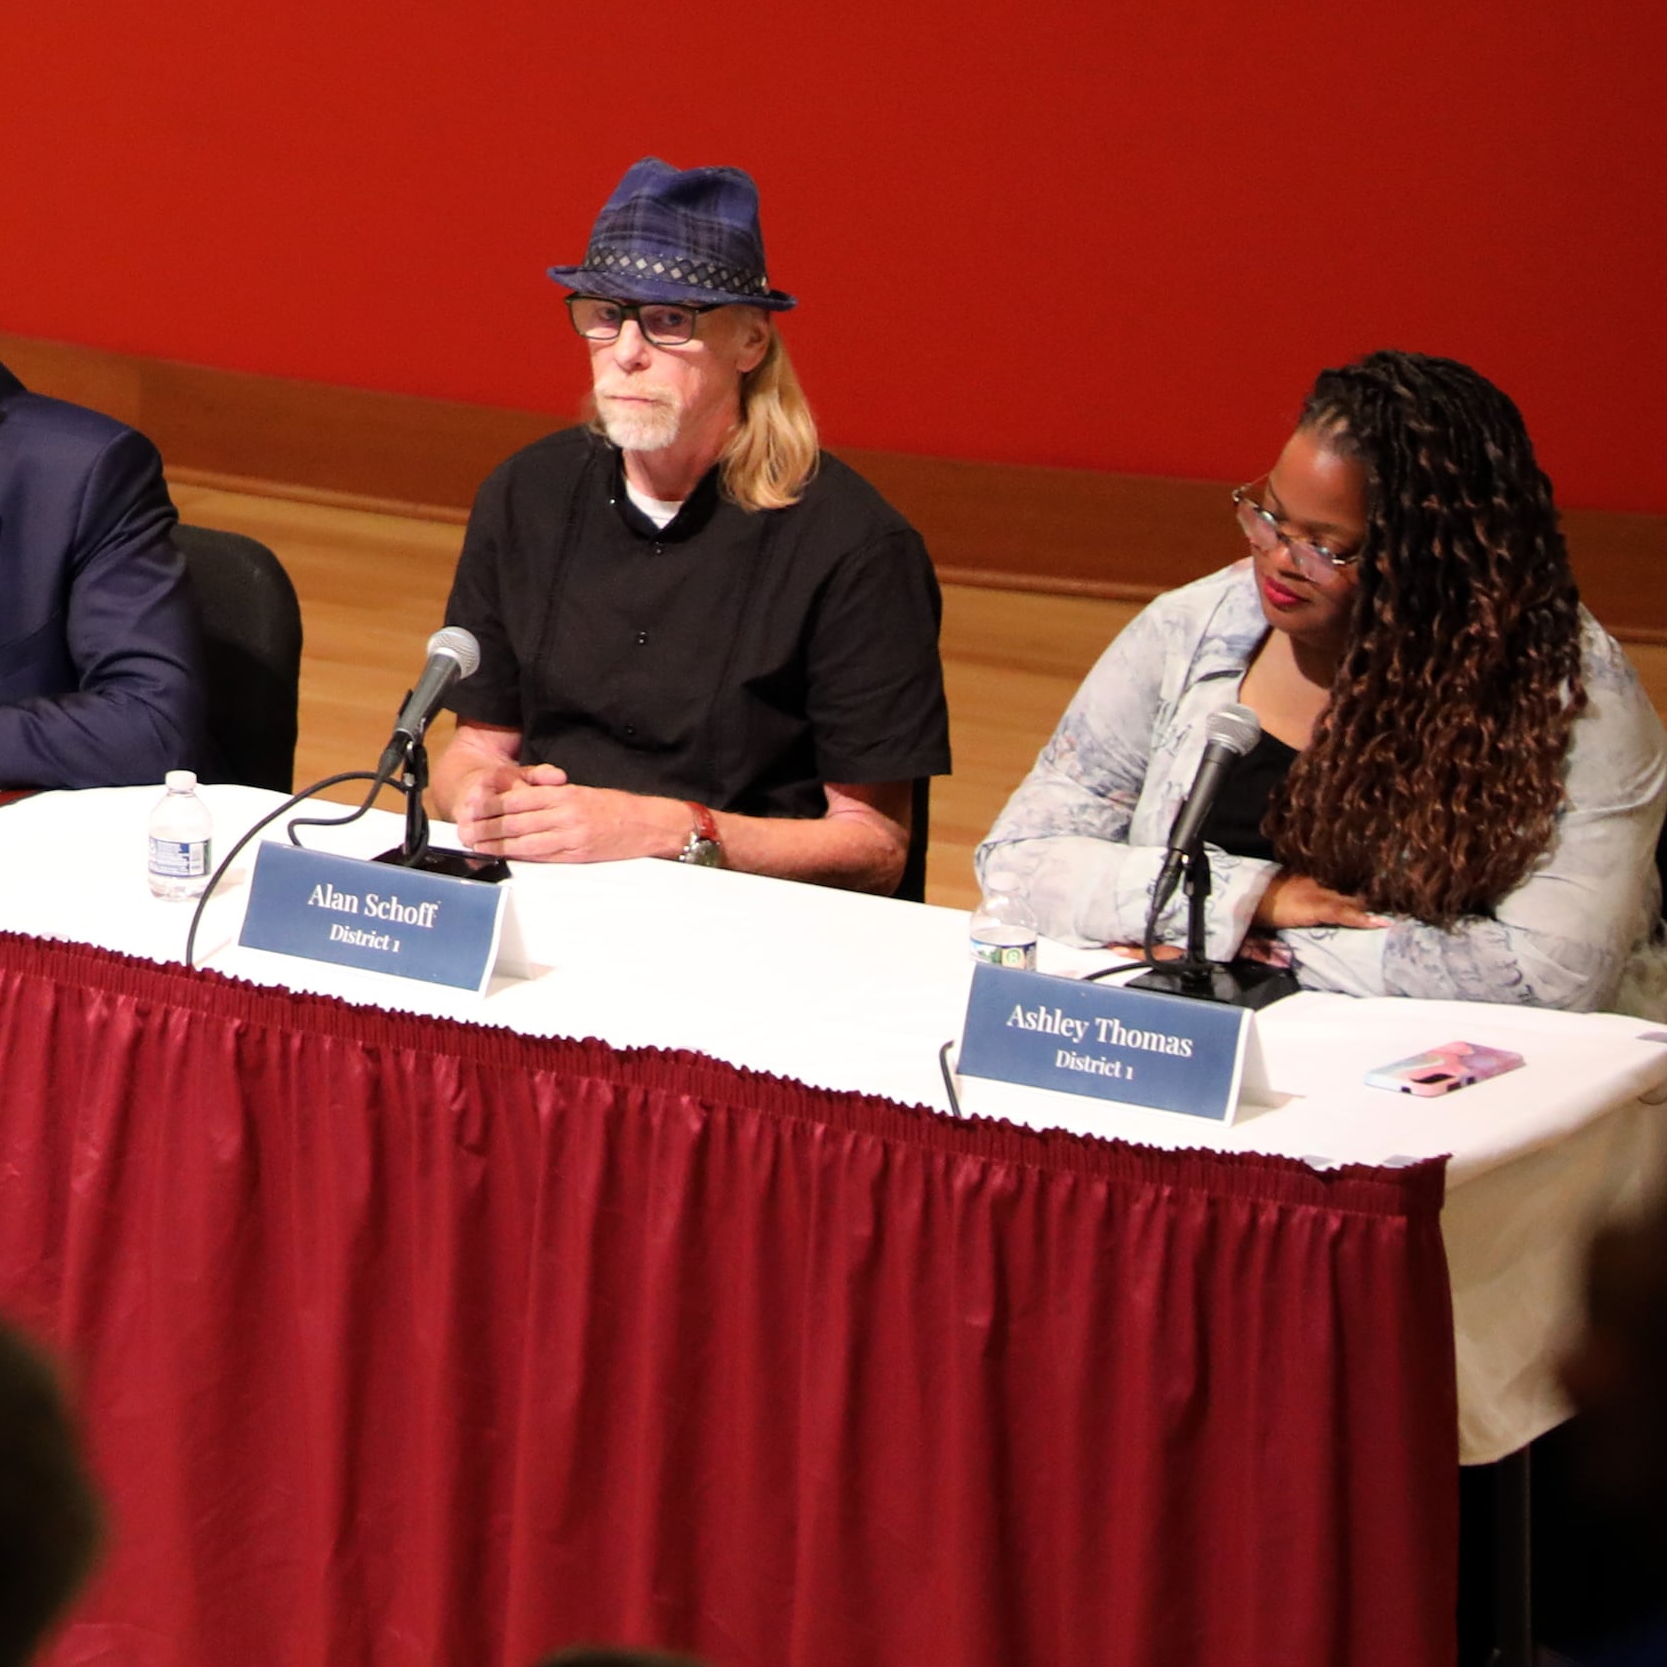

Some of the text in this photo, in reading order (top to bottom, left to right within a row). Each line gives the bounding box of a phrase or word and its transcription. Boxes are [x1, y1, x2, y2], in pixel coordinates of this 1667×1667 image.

[307, 883, 439, 928] Alan Schoff
[329, 924, 401, 953] District 1
[1006, 1003, 1194, 1057] Ashley Thomas
[1055, 1049, 1134, 1080] District 1
